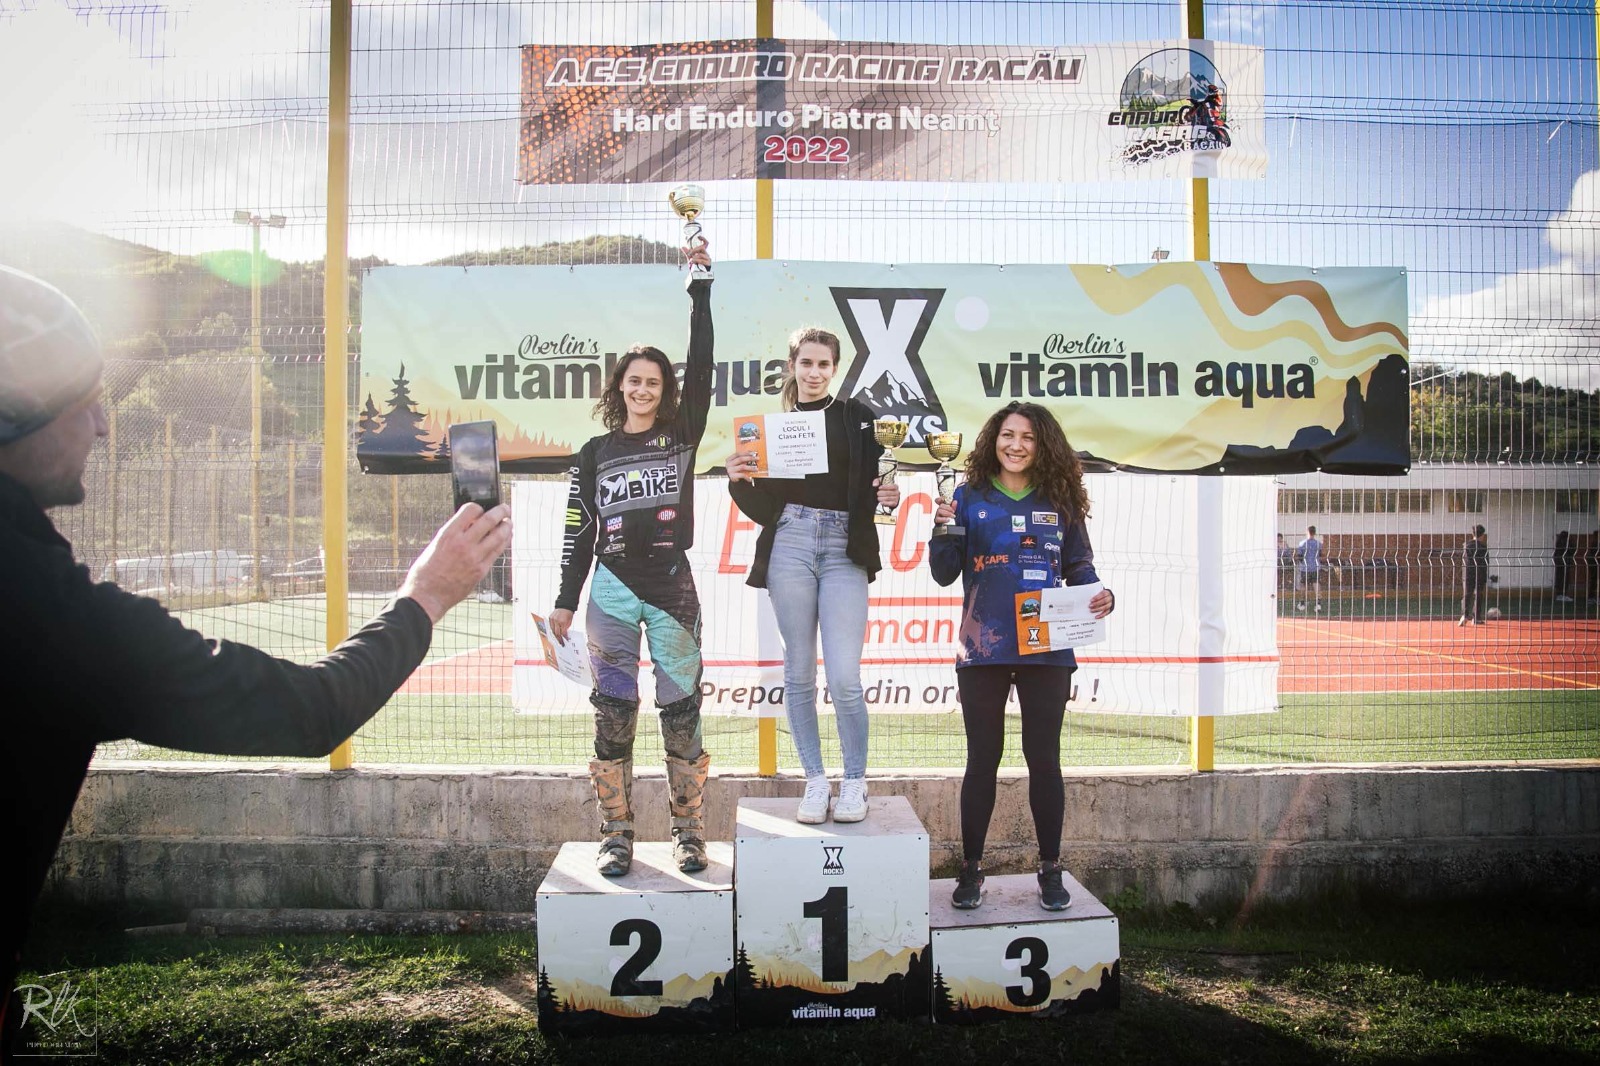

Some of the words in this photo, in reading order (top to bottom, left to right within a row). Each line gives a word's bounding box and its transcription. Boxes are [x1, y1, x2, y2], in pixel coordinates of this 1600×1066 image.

[649, 52, 796, 84] ENDURO
[798, 53, 944, 84] RACING
[947, 50, 1086, 84] BACĂU
[612, 105, 682, 132] Hard
[689, 104, 795, 131] Enduro
[801, 103, 893, 131] Piatra
[763, 135, 849, 163] 2022
[518, 333, 600, 360] Merlin's
[1043, 333, 1126, 359] Merlin's
[978, 352, 1179, 398] vitam!n
[1194, 360, 1316, 408] aqua
[798, 431, 816, 439] FETE
[629, 474, 678, 499] BIKE
[864, 679, 911, 704] din
[803, 886, 849, 982] 1
[609, 918, 663, 997] 2
[1005, 936, 1051, 1008] 3
[792, 1006, 841, 1019] vitam!n
[843, 1007, 876, 1020] aqua
